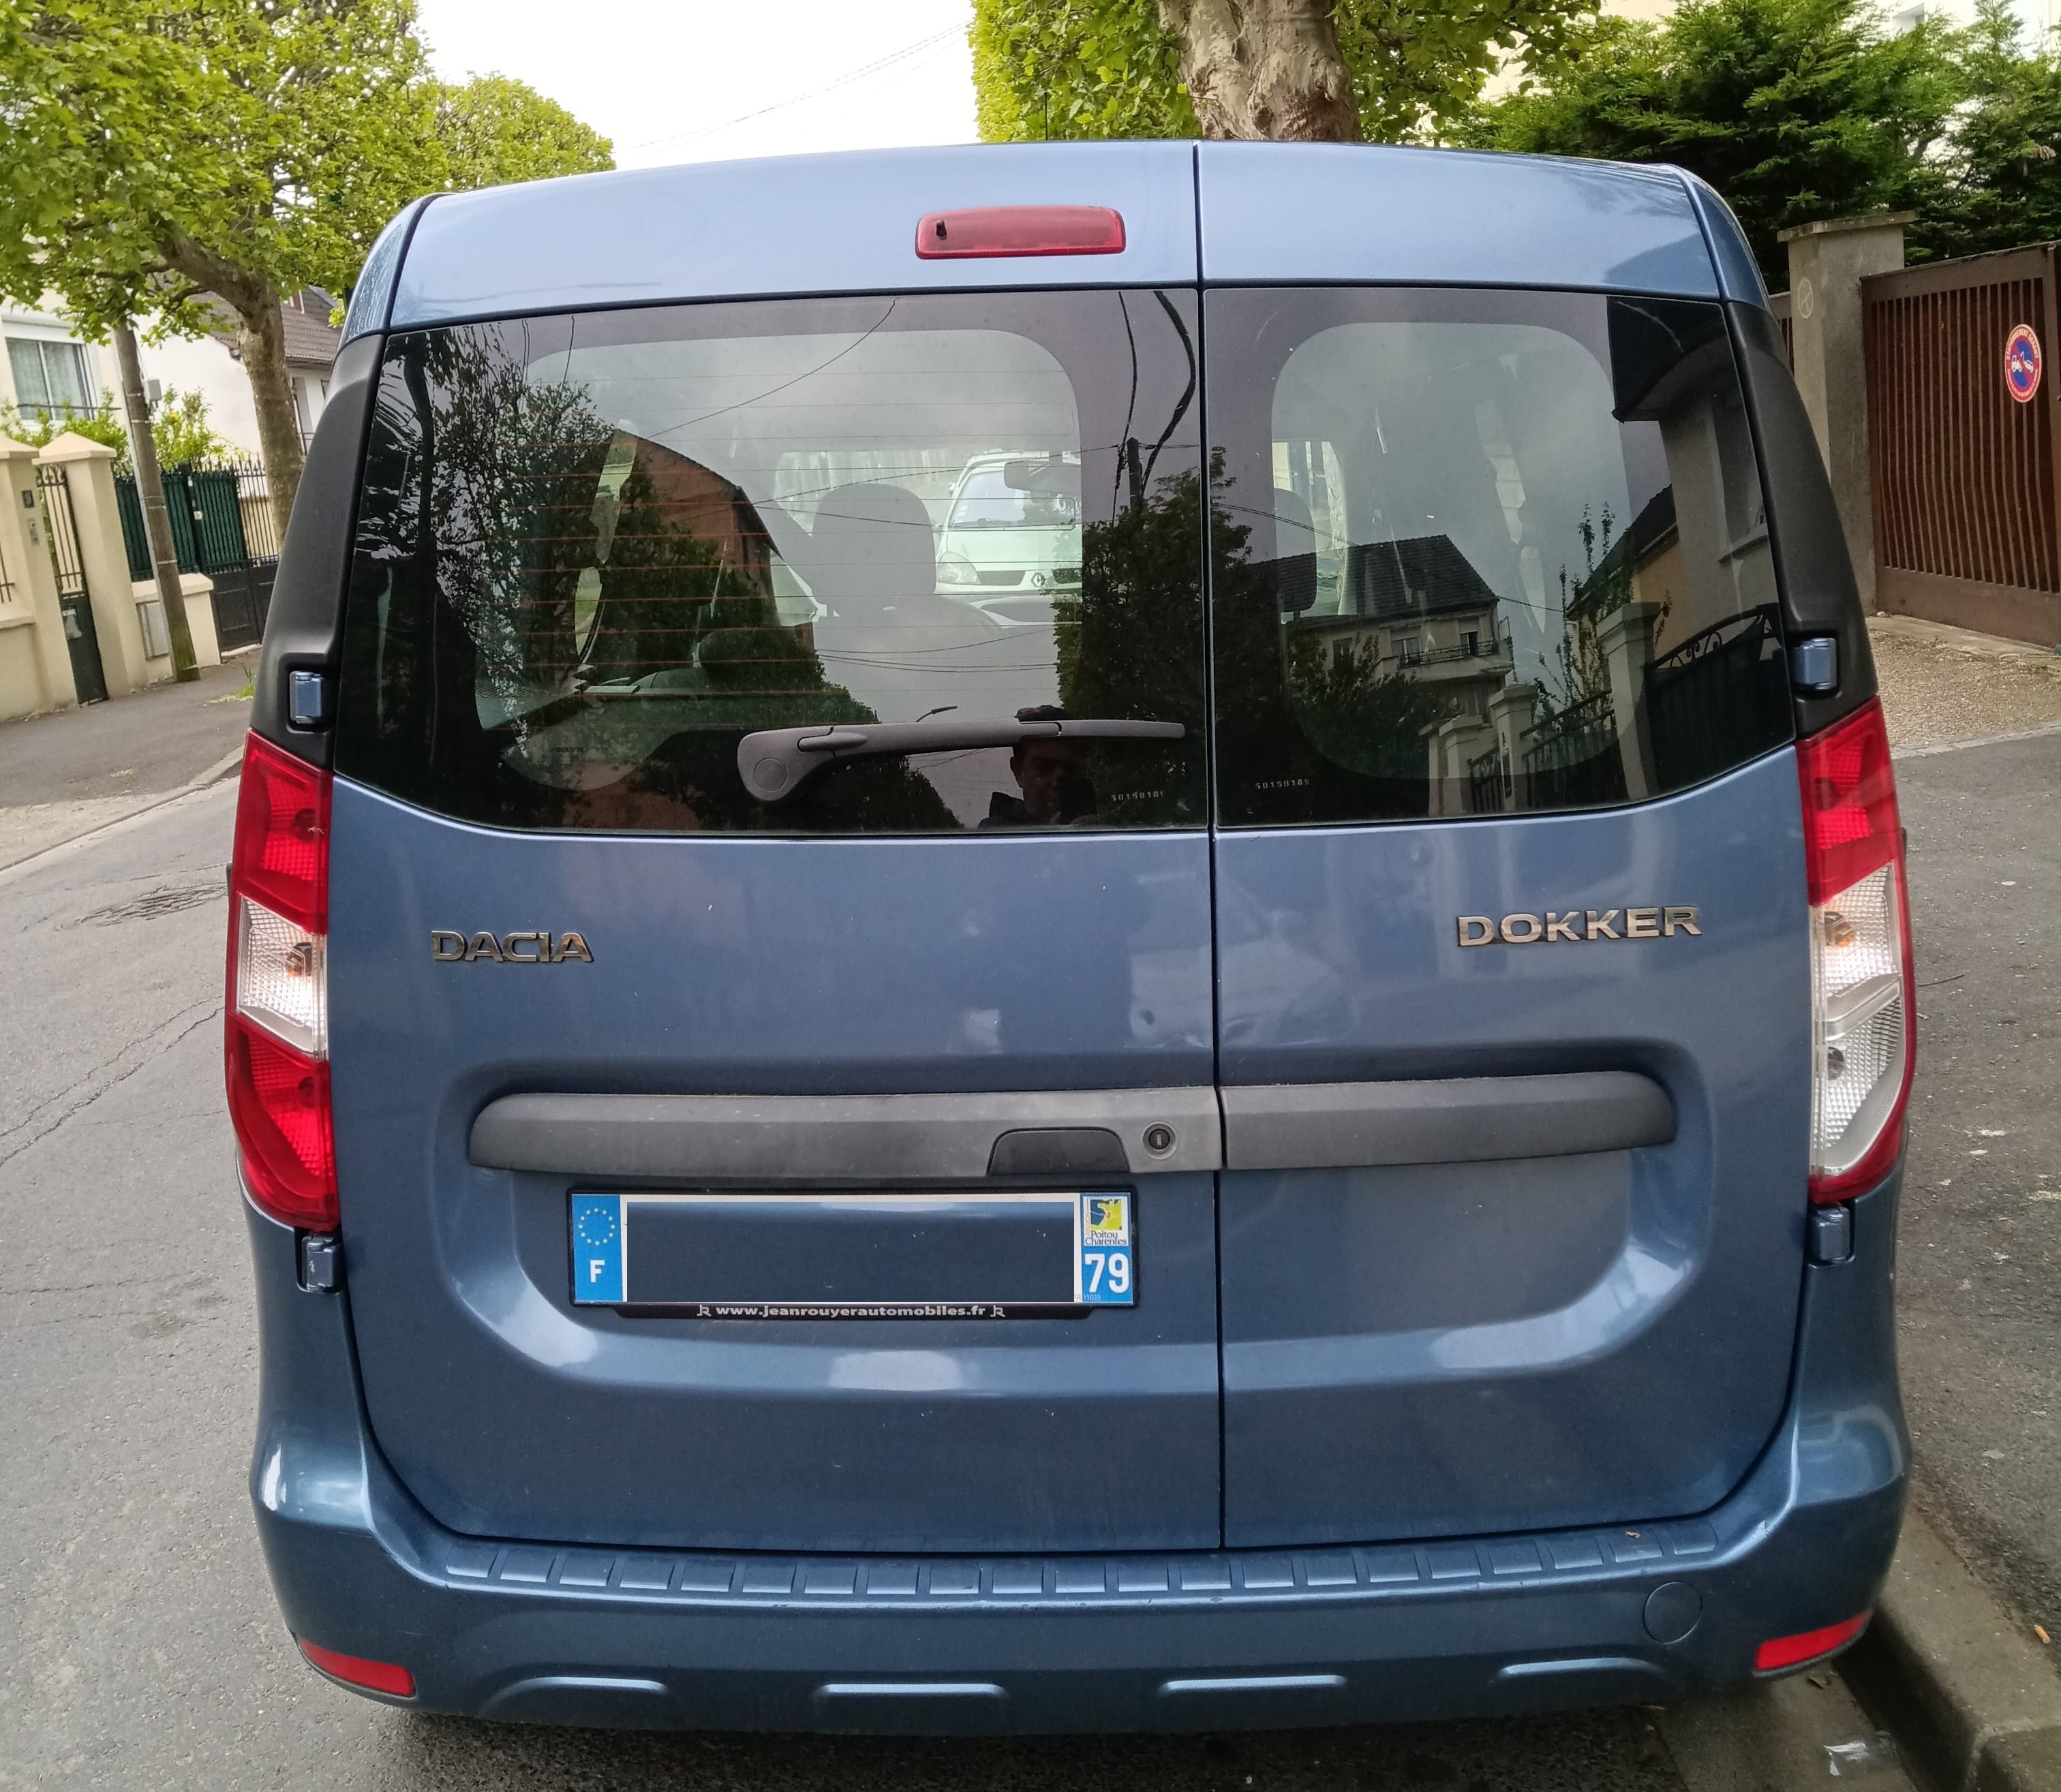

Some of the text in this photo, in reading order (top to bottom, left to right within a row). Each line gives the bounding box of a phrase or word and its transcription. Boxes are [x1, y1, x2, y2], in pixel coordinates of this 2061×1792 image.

[1456, 906, 1703, 946] DOKKER
[431, 931, 594, 962] DACIA
[1085, 1237, 1127, 1246] Charentes
[1090, 1231, 1118, 1239] Poitou
[590, 1260, 605, 1283] F
[1085, 1252, 1129, 1293] 79
[716, 1305, 986, 1317] www.jeanrouyerautomobiles.fr
